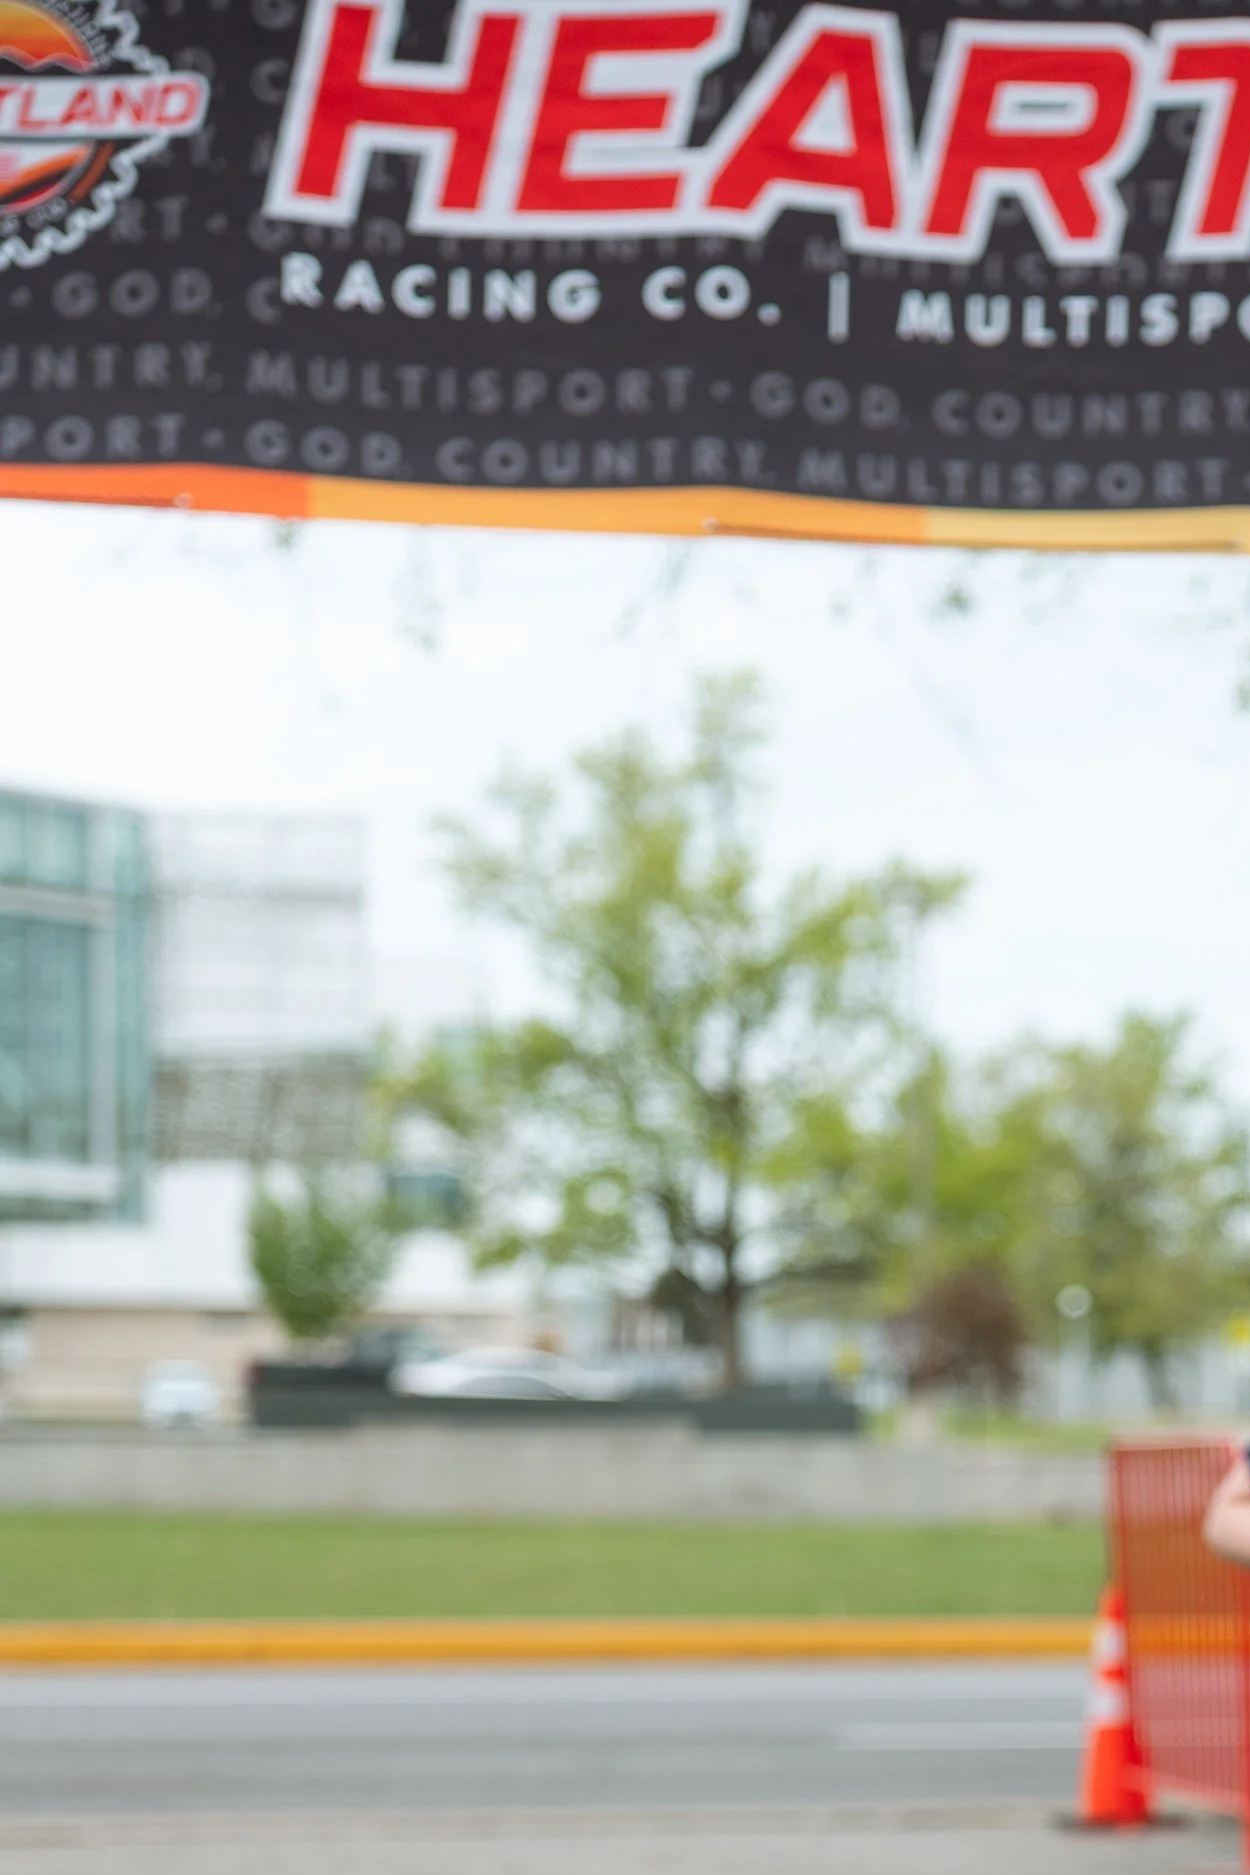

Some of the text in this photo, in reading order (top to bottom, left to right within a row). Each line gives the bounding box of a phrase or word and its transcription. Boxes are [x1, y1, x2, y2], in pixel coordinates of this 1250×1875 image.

[280, 252, 602, 324] RACING
[641, 265, 782, 326] CO.
[246, 349, 694, 417] MULTISPORT
[797, 446, 1228, 507] MULTISPORT
